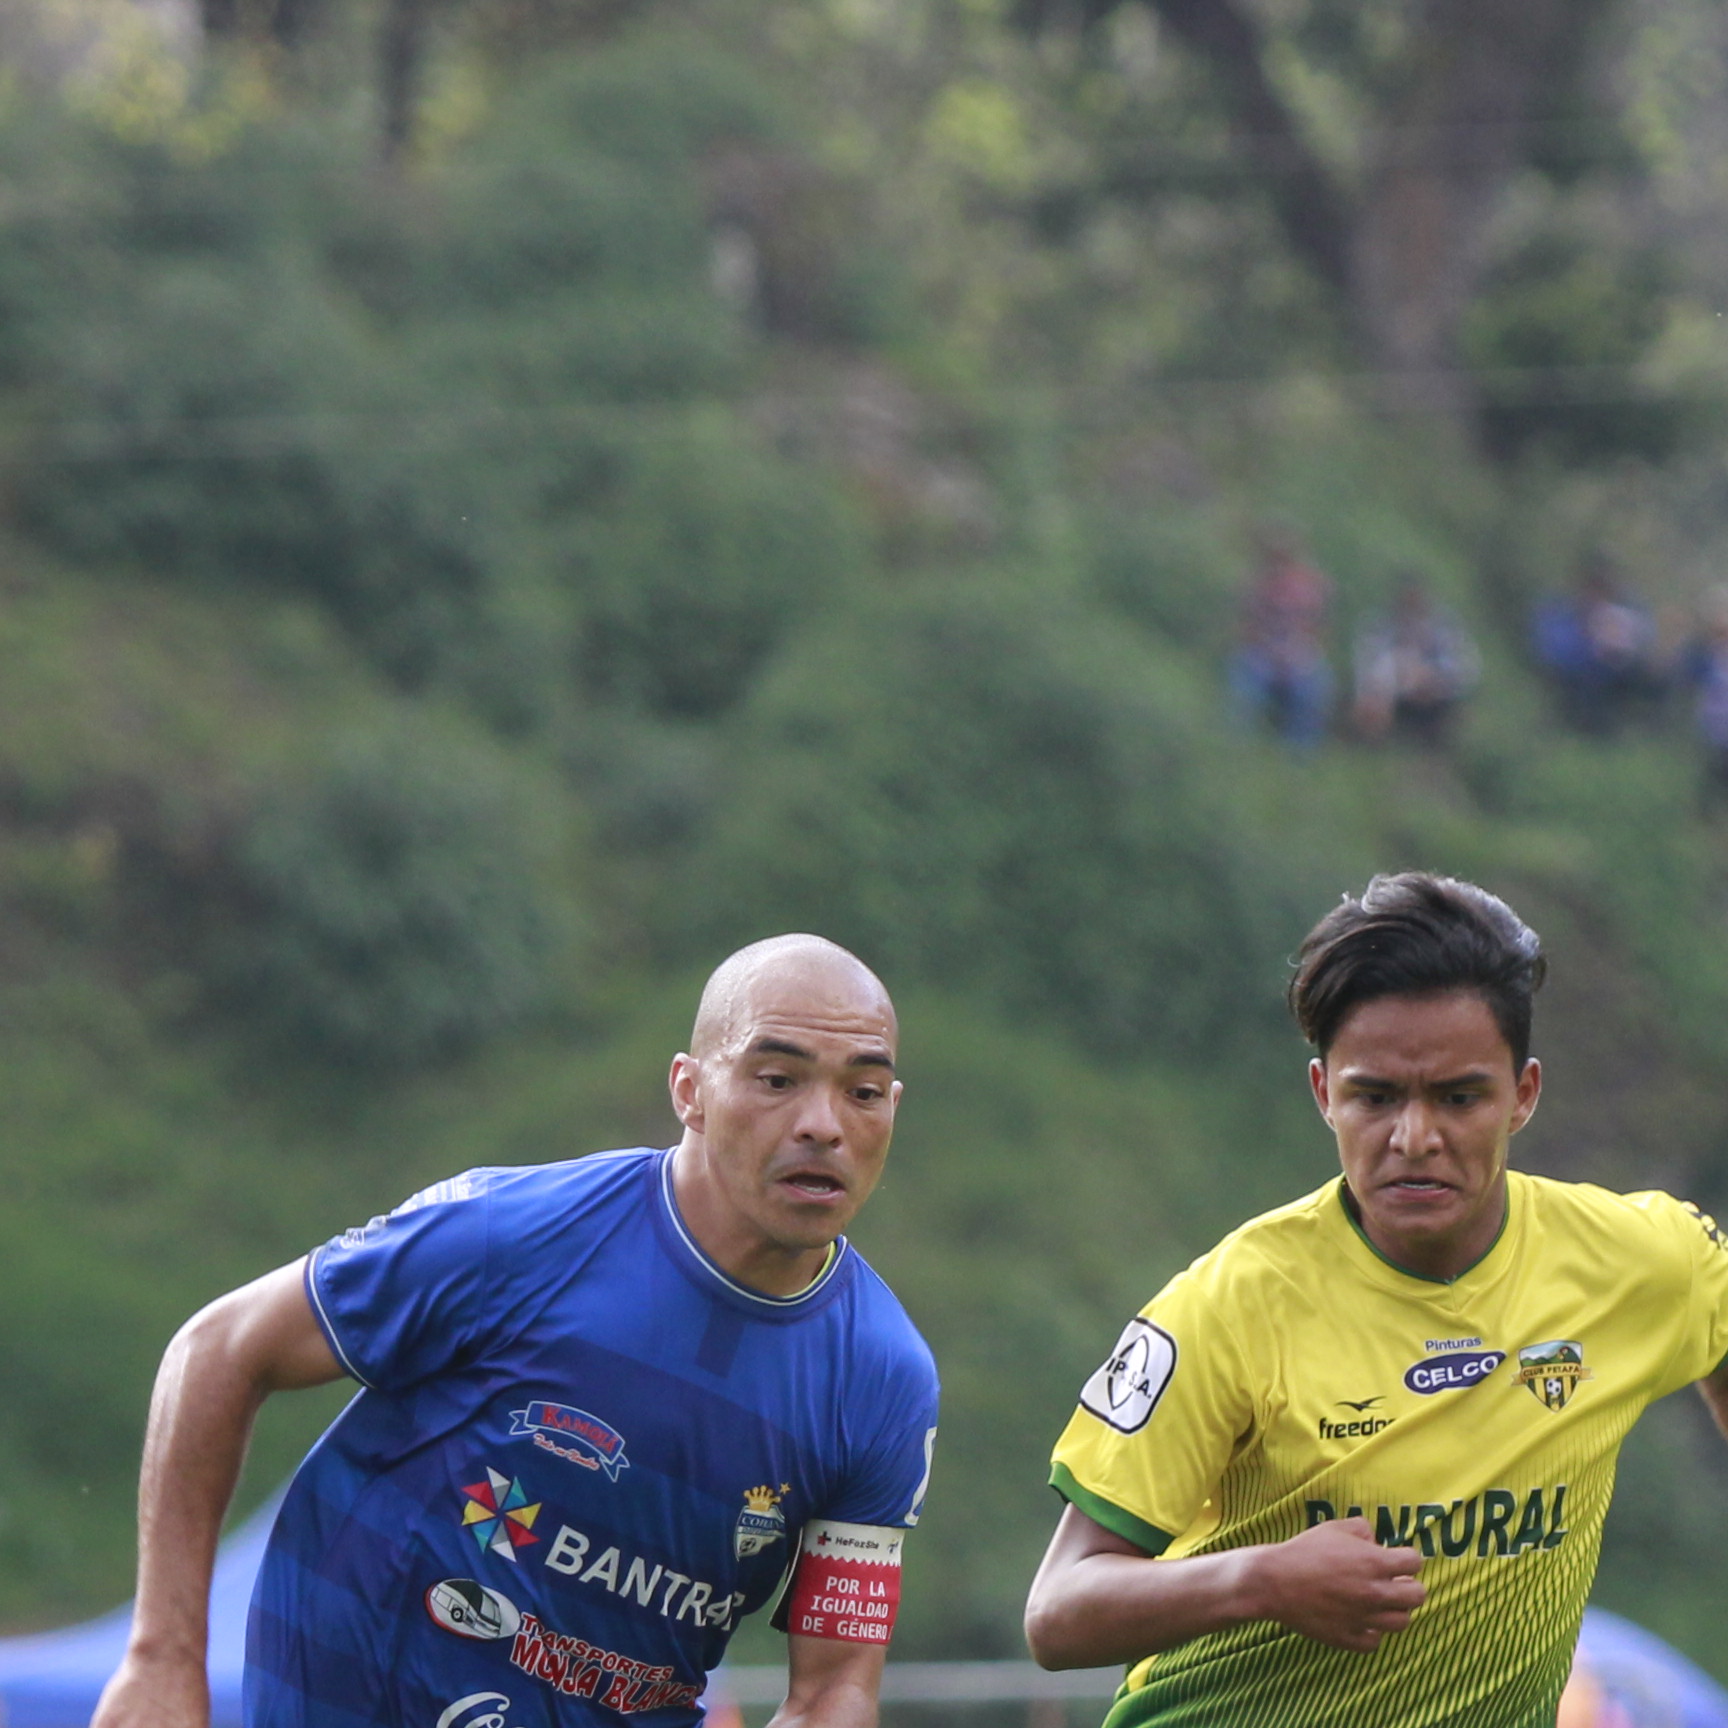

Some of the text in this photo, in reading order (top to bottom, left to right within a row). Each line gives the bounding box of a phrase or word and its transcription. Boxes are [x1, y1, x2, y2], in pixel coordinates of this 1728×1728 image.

[1425, 1336, 1483, 1351] Pinturas
[1412, 1355, 1499, 1388] CELCO
[1319, 1415, 1396, 1440] freedo
[544, 1524, 746, 1632] BANTRA
[825, 1575, 886, 1597] POR LA
[810, 1595, 889, 1619] IGUALDAD
[802, 1615, 887, 1640] DE GÉNERO
